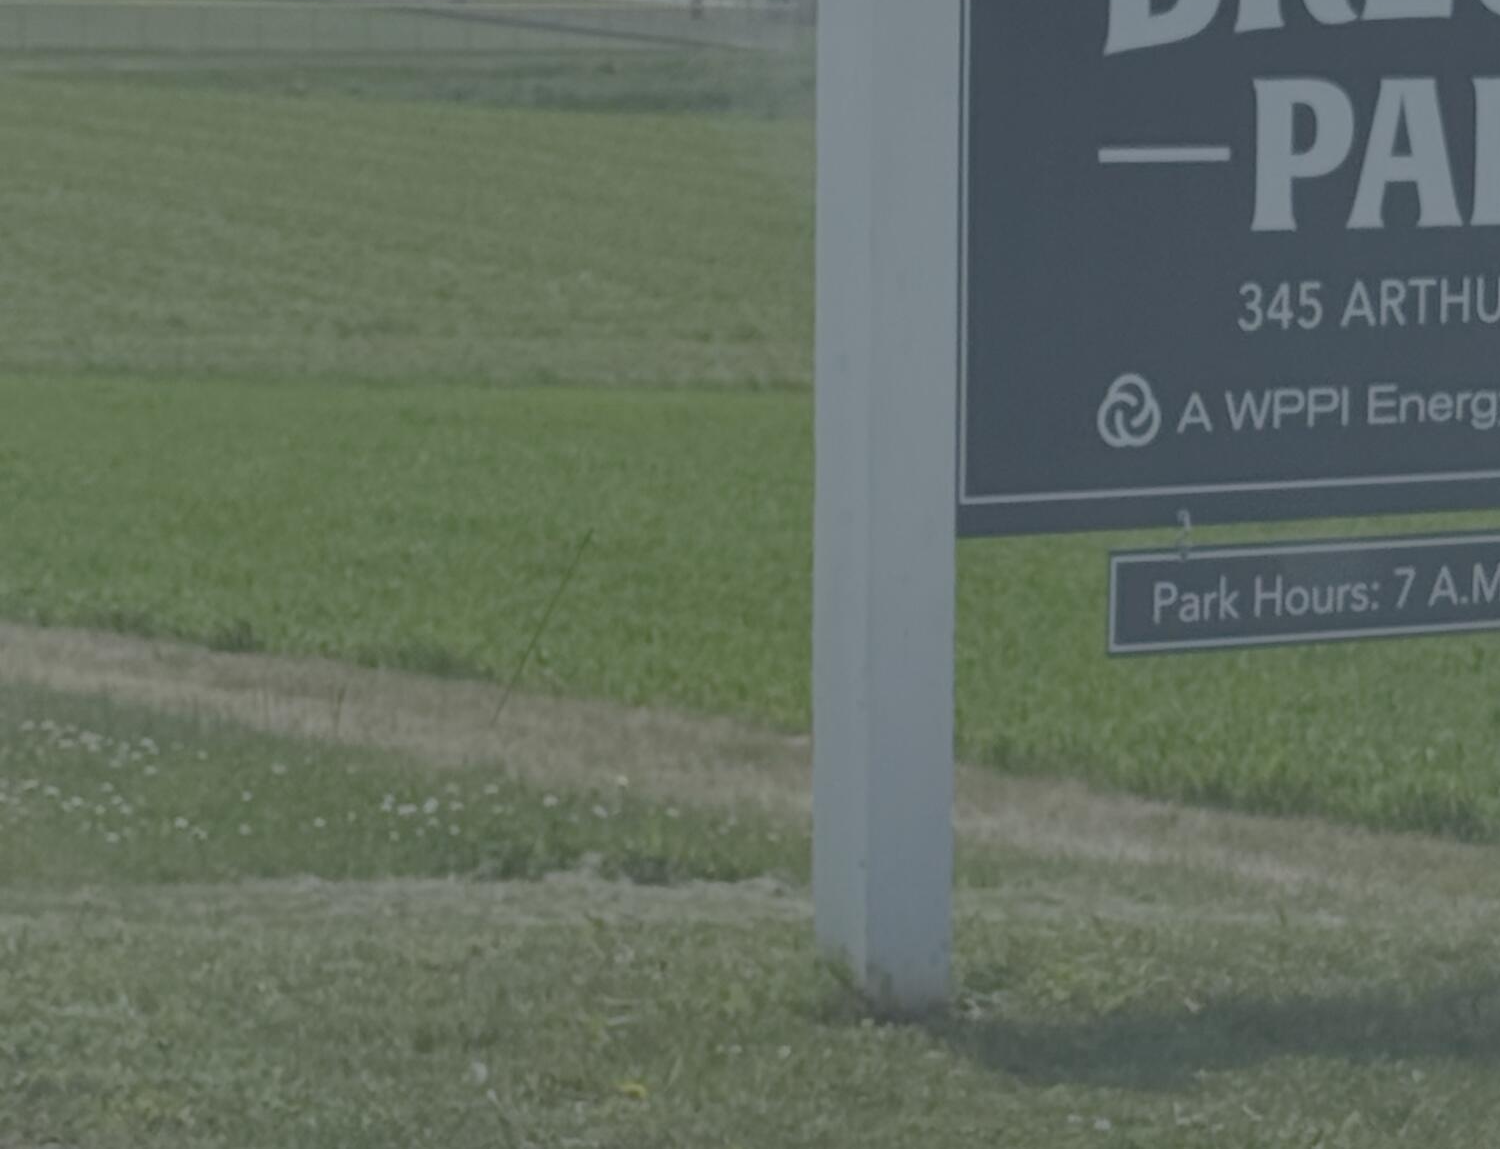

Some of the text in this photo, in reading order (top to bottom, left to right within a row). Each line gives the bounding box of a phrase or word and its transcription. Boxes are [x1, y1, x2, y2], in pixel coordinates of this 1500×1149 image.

[1237, 280, 1324, 332] 345
[1177, 391, 1213, 434] A
[1225, 385, 1350, 431] WPPI
[1152, 575, 1240, 625] Park
[1253, 571, 1381, 618] Hours:
[1395, 568, 1417, 609] 7
